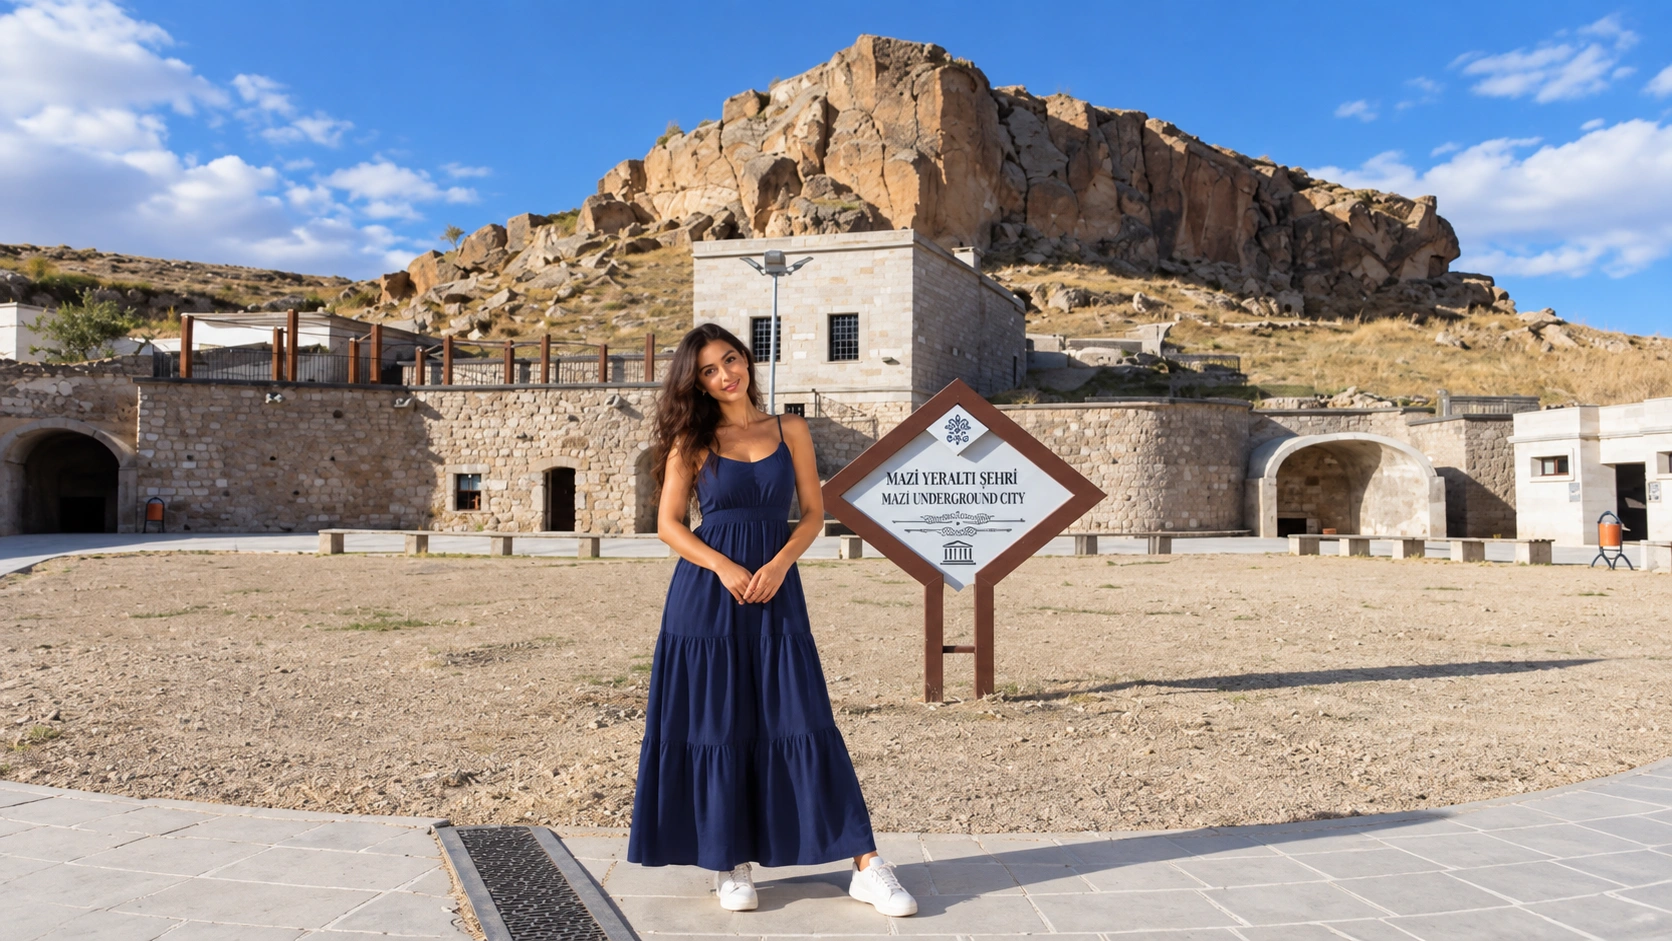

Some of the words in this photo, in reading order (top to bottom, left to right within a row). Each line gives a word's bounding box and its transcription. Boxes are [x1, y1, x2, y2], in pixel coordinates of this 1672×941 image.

[886, 469, 919, 486] MAZİ
[922, 471, 976, 486] YERALTI
[980, 468, 1018, 489] ŞEHRİ
[913, 492, 998, 505] UNDERGROUND
[1000, 492, 1026, 505] CITY
